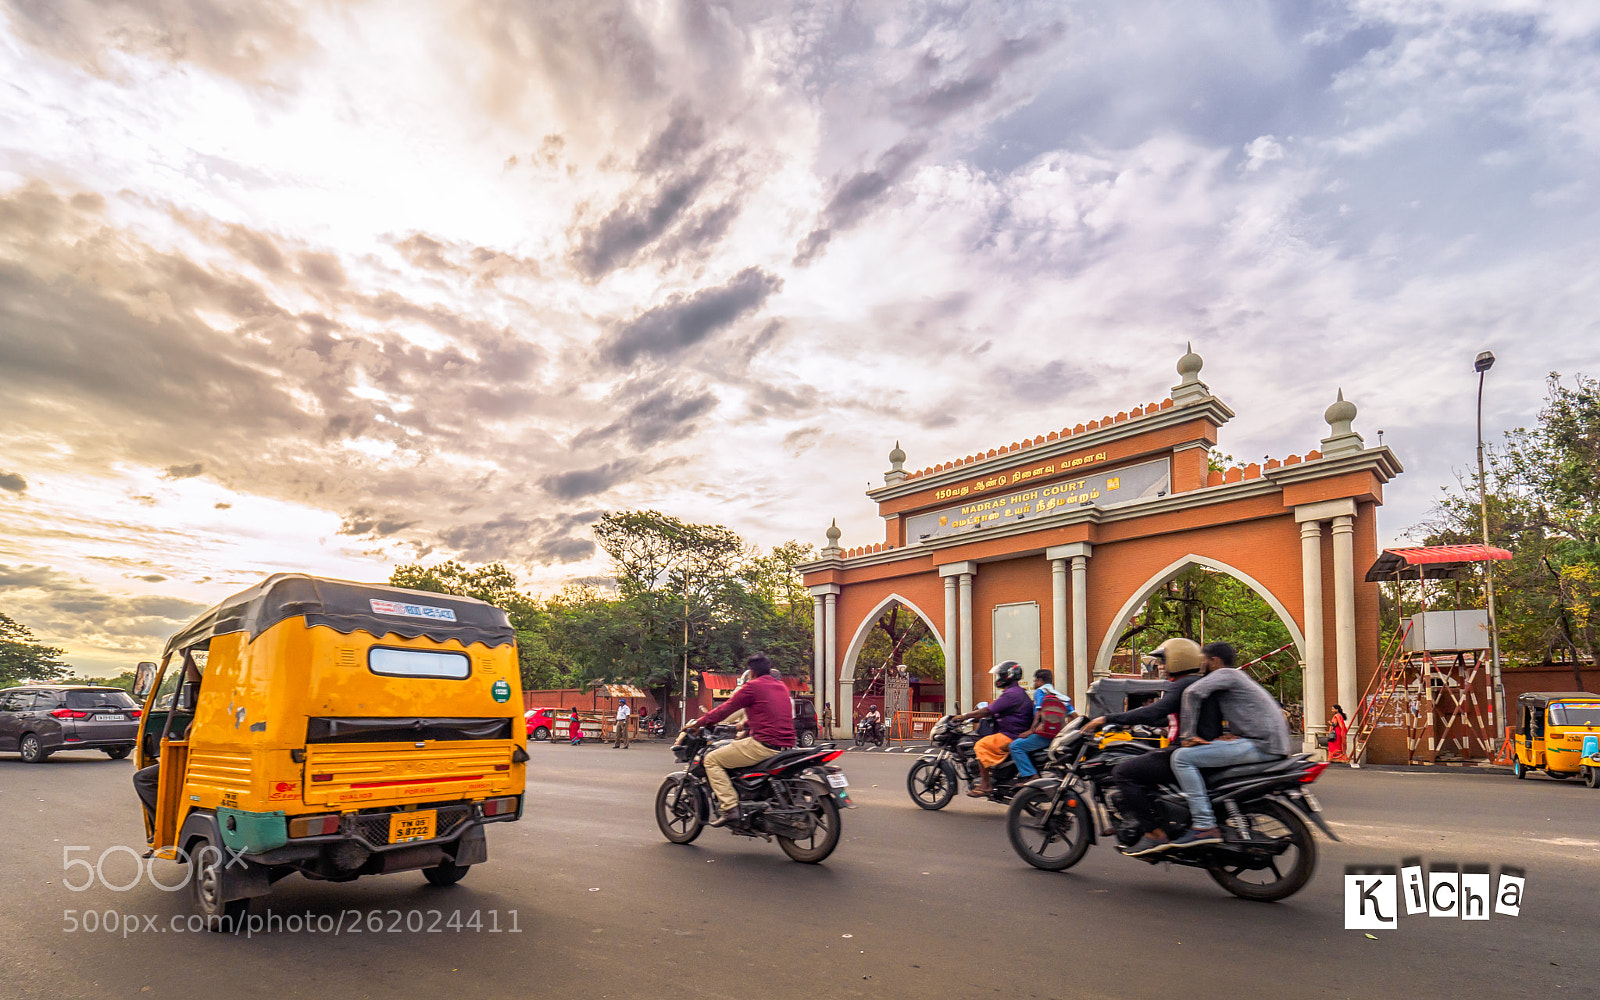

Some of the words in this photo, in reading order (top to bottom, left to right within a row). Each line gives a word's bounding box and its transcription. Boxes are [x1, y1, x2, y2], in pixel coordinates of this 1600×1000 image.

[935, 486, 969, 500] 150வது
[974, 475, 1007, 491] ஆண்டு
[1012, 465, 1055, 484] நினைவு
[1061, 452, 1106, 469] வளைவு
[961, 498, 1006, 515] MADRAS
[1010, 491, 1038, 504] HIGH
[1043, 480, 1086, 497] COURT
[1004, 503, 1031, 517] உயர்
[1036, 488, 1100, 513] நீதிமன்றம்
[396, 829, 403, 837] S
[405, 827, 428, 836] 8722
